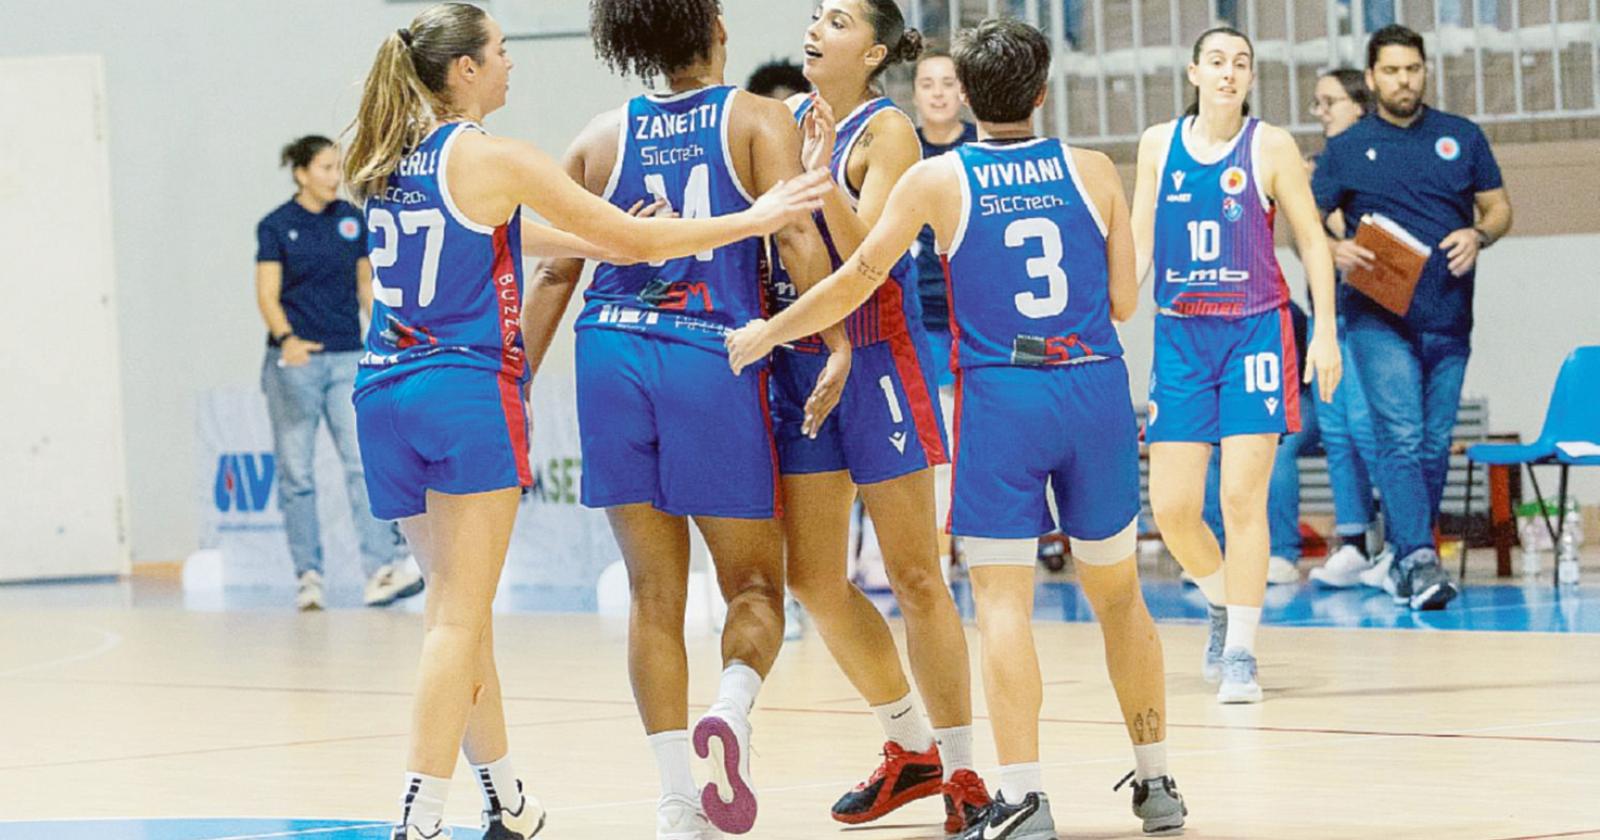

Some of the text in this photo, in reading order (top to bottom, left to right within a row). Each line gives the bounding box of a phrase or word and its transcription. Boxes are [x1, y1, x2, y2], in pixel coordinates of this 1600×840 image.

[635, 104, 717, 140] ZANETTI
[973, 157, 1064, 189] VIVIANI
[368, 208, 446, 308] 27
[1187, 220, 1220, 262] 10
[1004, 217, 1069, 319] 3
[1166, 267, 1250, 284] tmb
[1244, 353, 1280, 393] 10
[879, 375, 904, 424] 1
